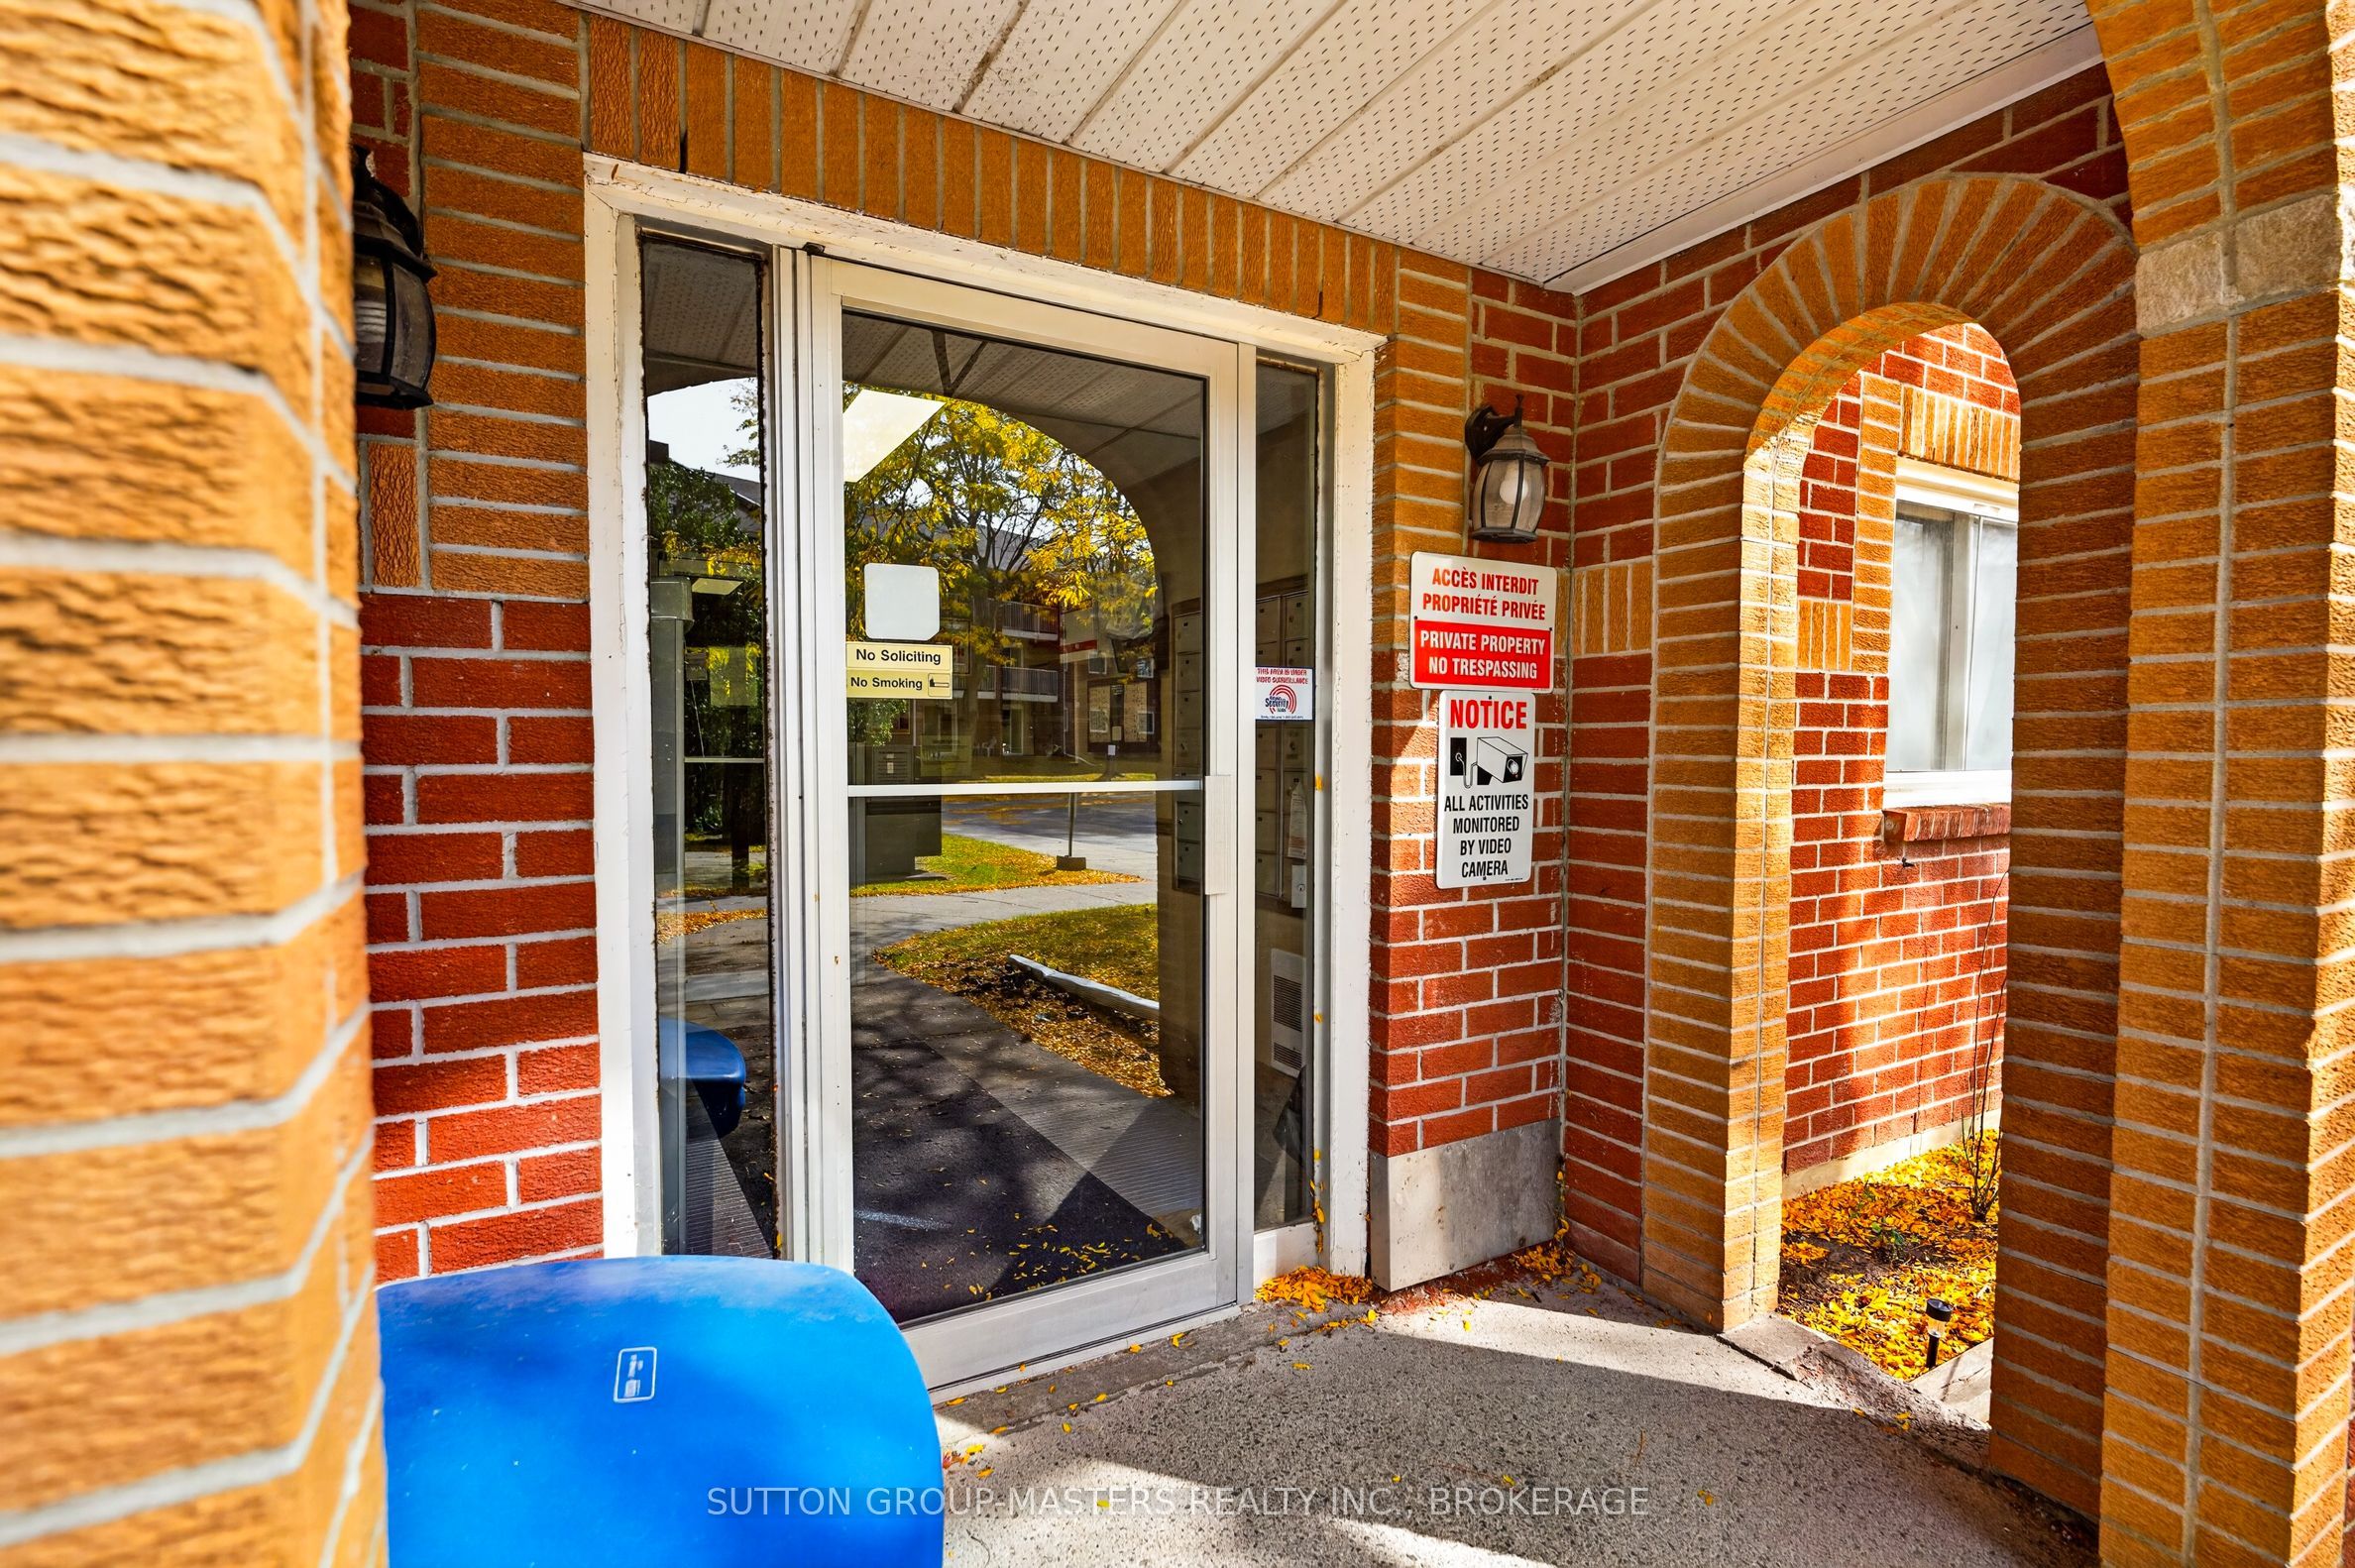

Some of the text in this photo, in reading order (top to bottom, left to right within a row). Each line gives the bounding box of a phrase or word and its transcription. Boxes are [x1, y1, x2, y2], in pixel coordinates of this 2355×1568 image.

[1432, 566, 1539, 596] ACCÈS INTERDIT
[1422, 594, 1546, 620] PROPRIÉTÉ PRIVÉE
[1419, 629, 1545, 655] PRIVATE PROPERTY
[855, 649, 942, 666] No Soliciting
[1428, 656, 1537, 680] NO TRESPASSING
[850, 677, 923, 691] No Smoking
[1450, 699, 1527, 729] NOTICE
[1444, 794, 1528, 812] ALL ACTIVITIES
[1453, 816, 1519, 834] MONITORED
[1460, 838, 1512, 856] BY VIDEO
[1461, 859, 1509, 878] CAMERA
